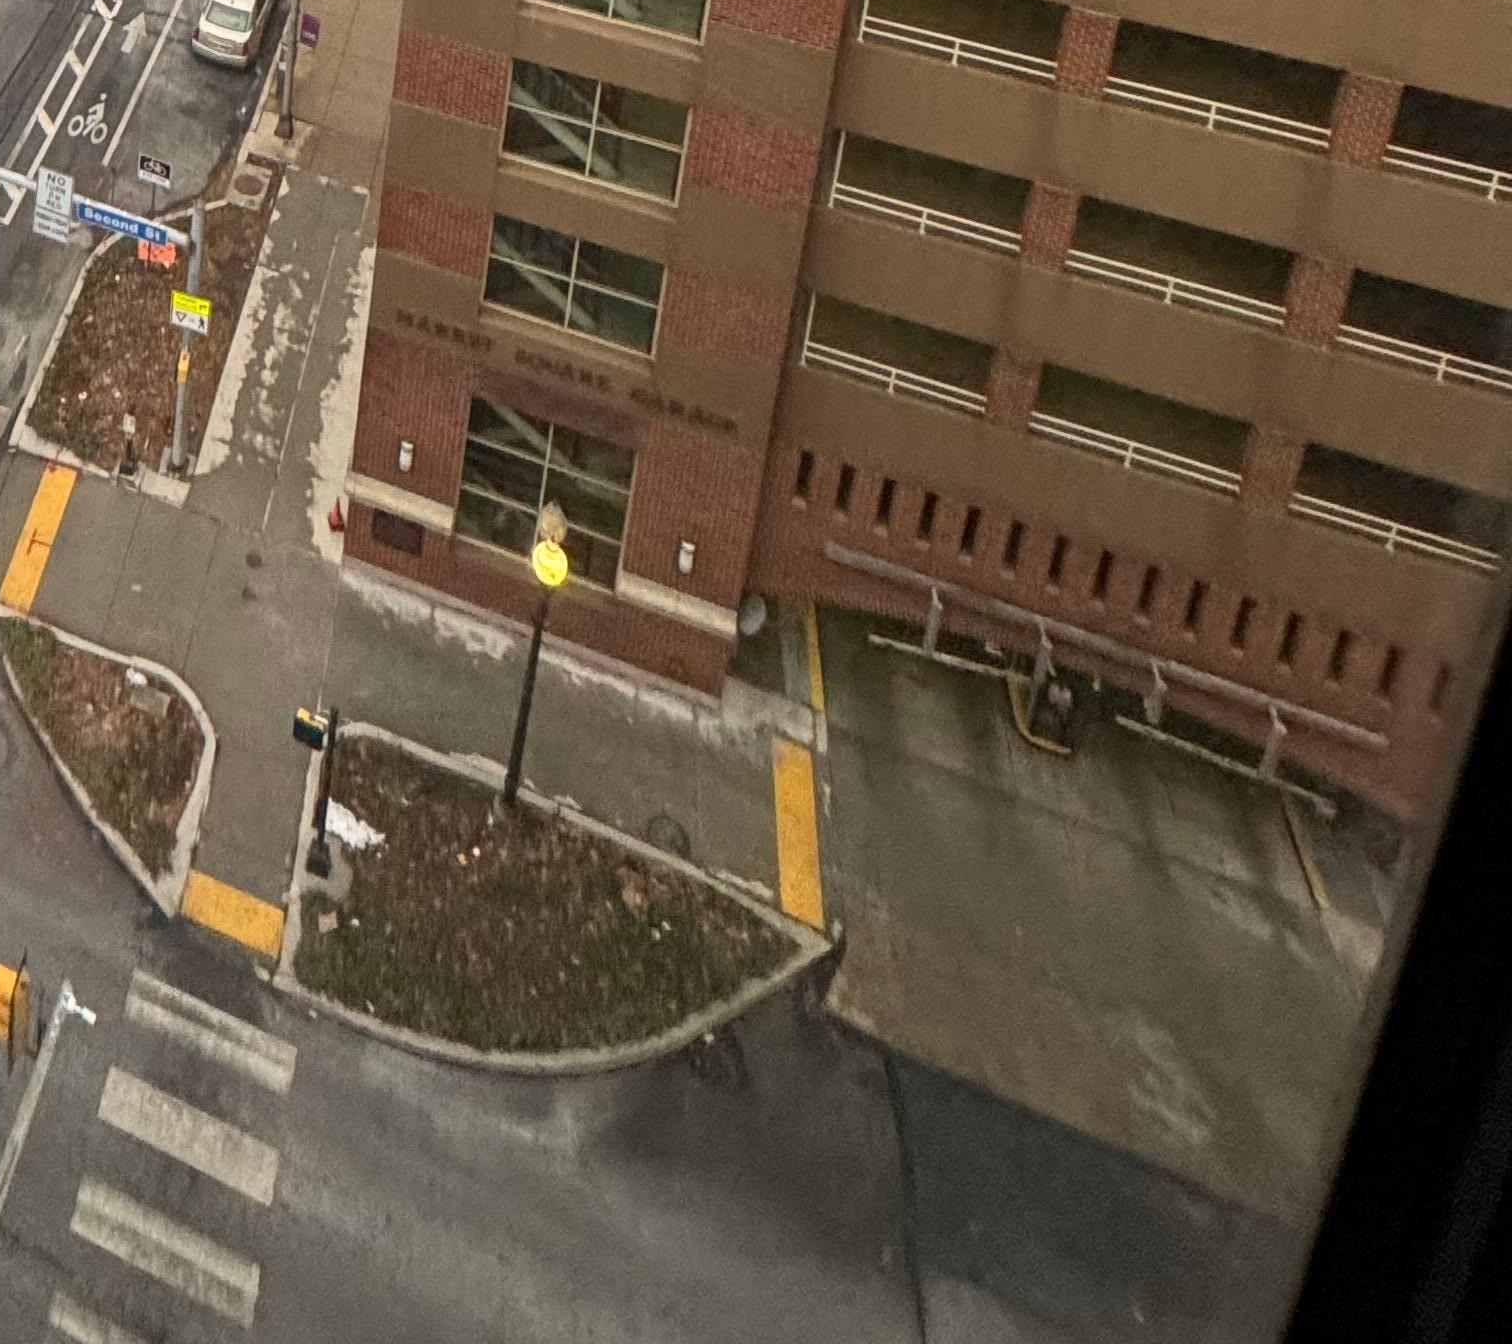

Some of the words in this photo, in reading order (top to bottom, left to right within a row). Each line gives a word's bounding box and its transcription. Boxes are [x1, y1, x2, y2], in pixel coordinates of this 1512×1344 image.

[47, 173, 66, 186] NO
[84, 207, 139, 234] Second
[144, 226, 161, 242] St
